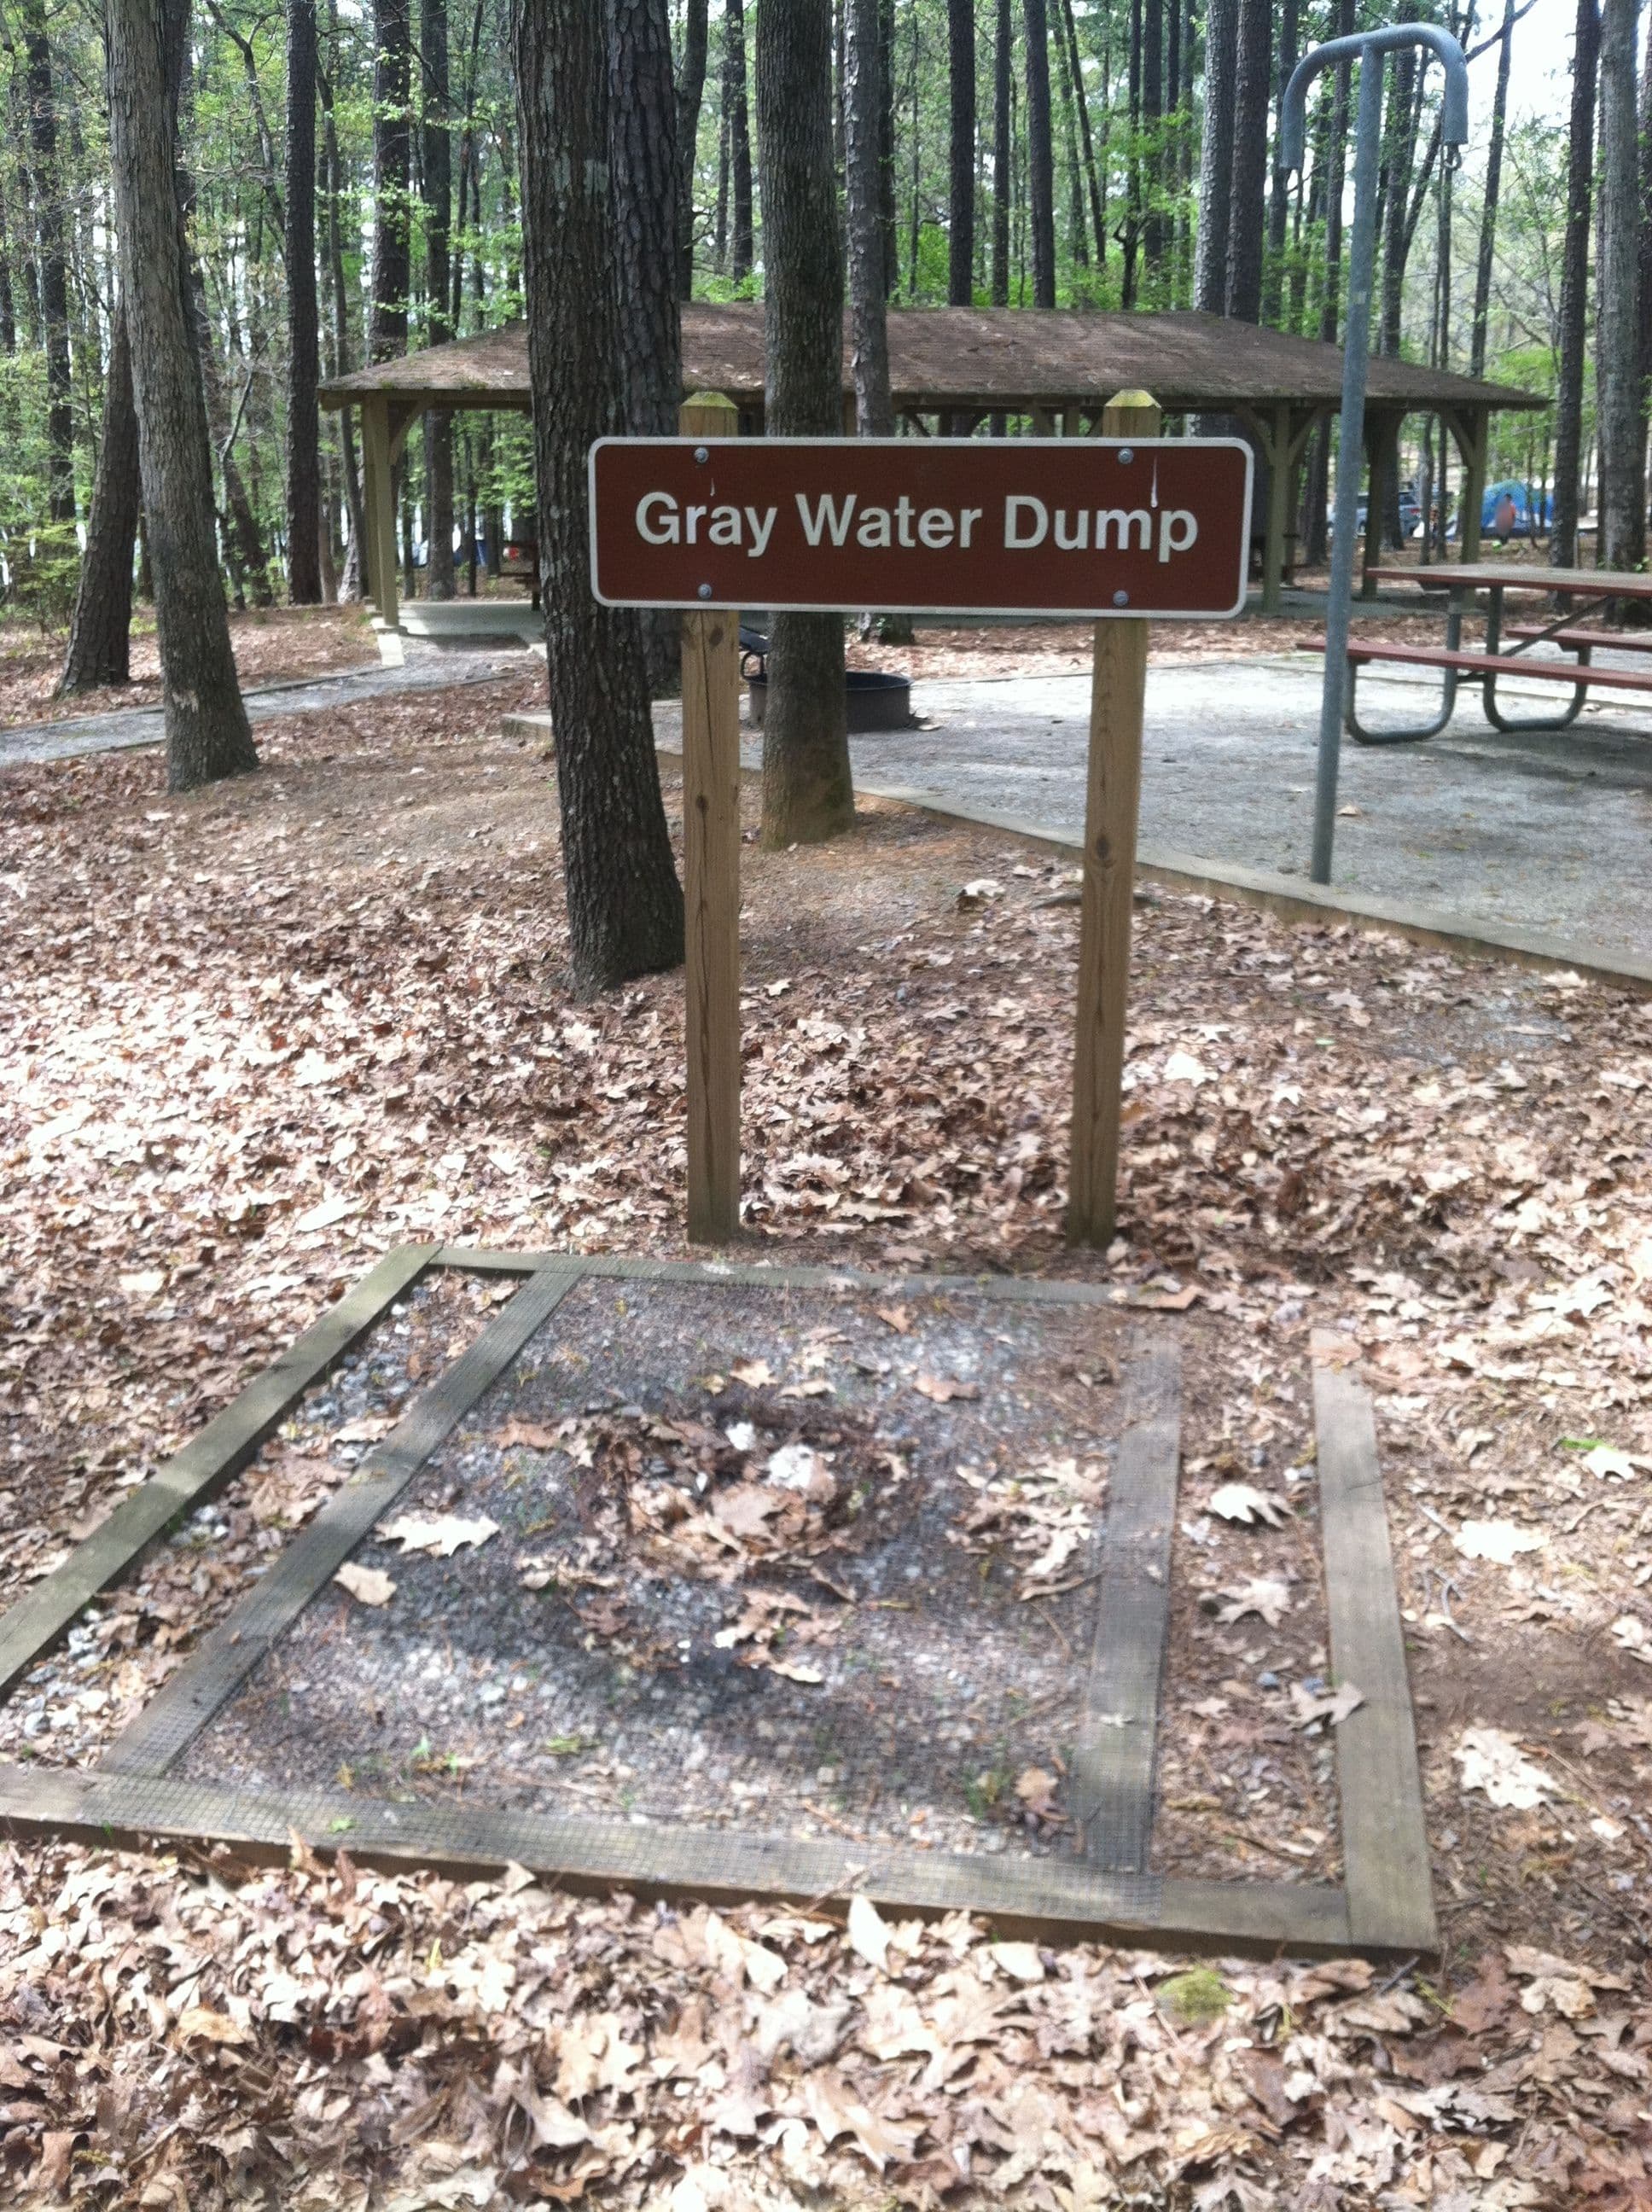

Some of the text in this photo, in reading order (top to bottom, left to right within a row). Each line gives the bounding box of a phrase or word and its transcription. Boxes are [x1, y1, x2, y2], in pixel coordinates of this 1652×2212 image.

[635, 491, 1198, 563] Gray Water Dump
